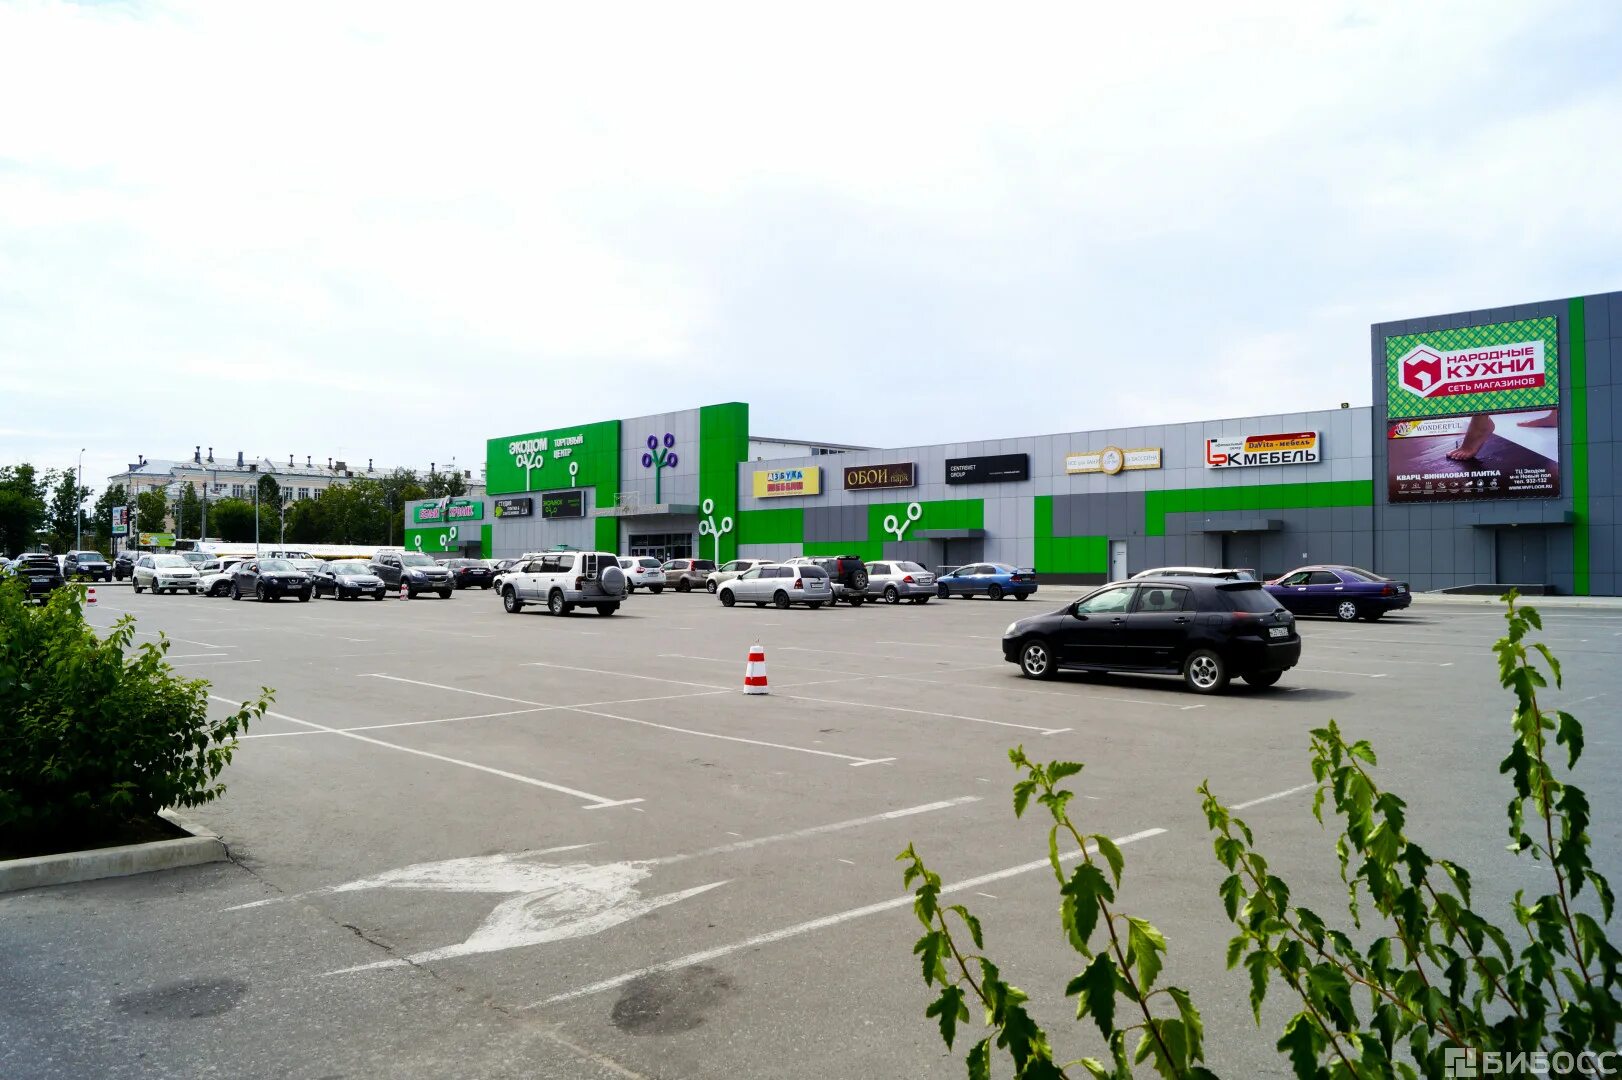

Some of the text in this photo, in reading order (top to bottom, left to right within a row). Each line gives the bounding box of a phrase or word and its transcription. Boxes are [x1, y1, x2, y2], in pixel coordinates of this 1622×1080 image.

[1447, 347, 1534, 364] НАРОДНЫЕ
[1447, 358, 1535, 379] КУХНИ
[1447, 377, 1536, 393] СЕТЬ МАГАЗИНОВ
[1417, 423, 1463, 432] WONDERFUL
[509, 437, 548, 455] ЭКОДОМ
[553, 434, 584, 447] ТОРГОВЫЙ
[1248, 441, 1274, 449] DaVita
[1280, 439, 1311, 447] мебель
[553, 448, 573, 459] ЦЕНТР
[1244, 450, 1317, 466] МЕБЕЛЬ
[767, 470, 804, 481] АЗБУКА
[847, 468, 909, 486] ОБОИ парк
[1471, 469, 1501, 478] ПЛИТКА
